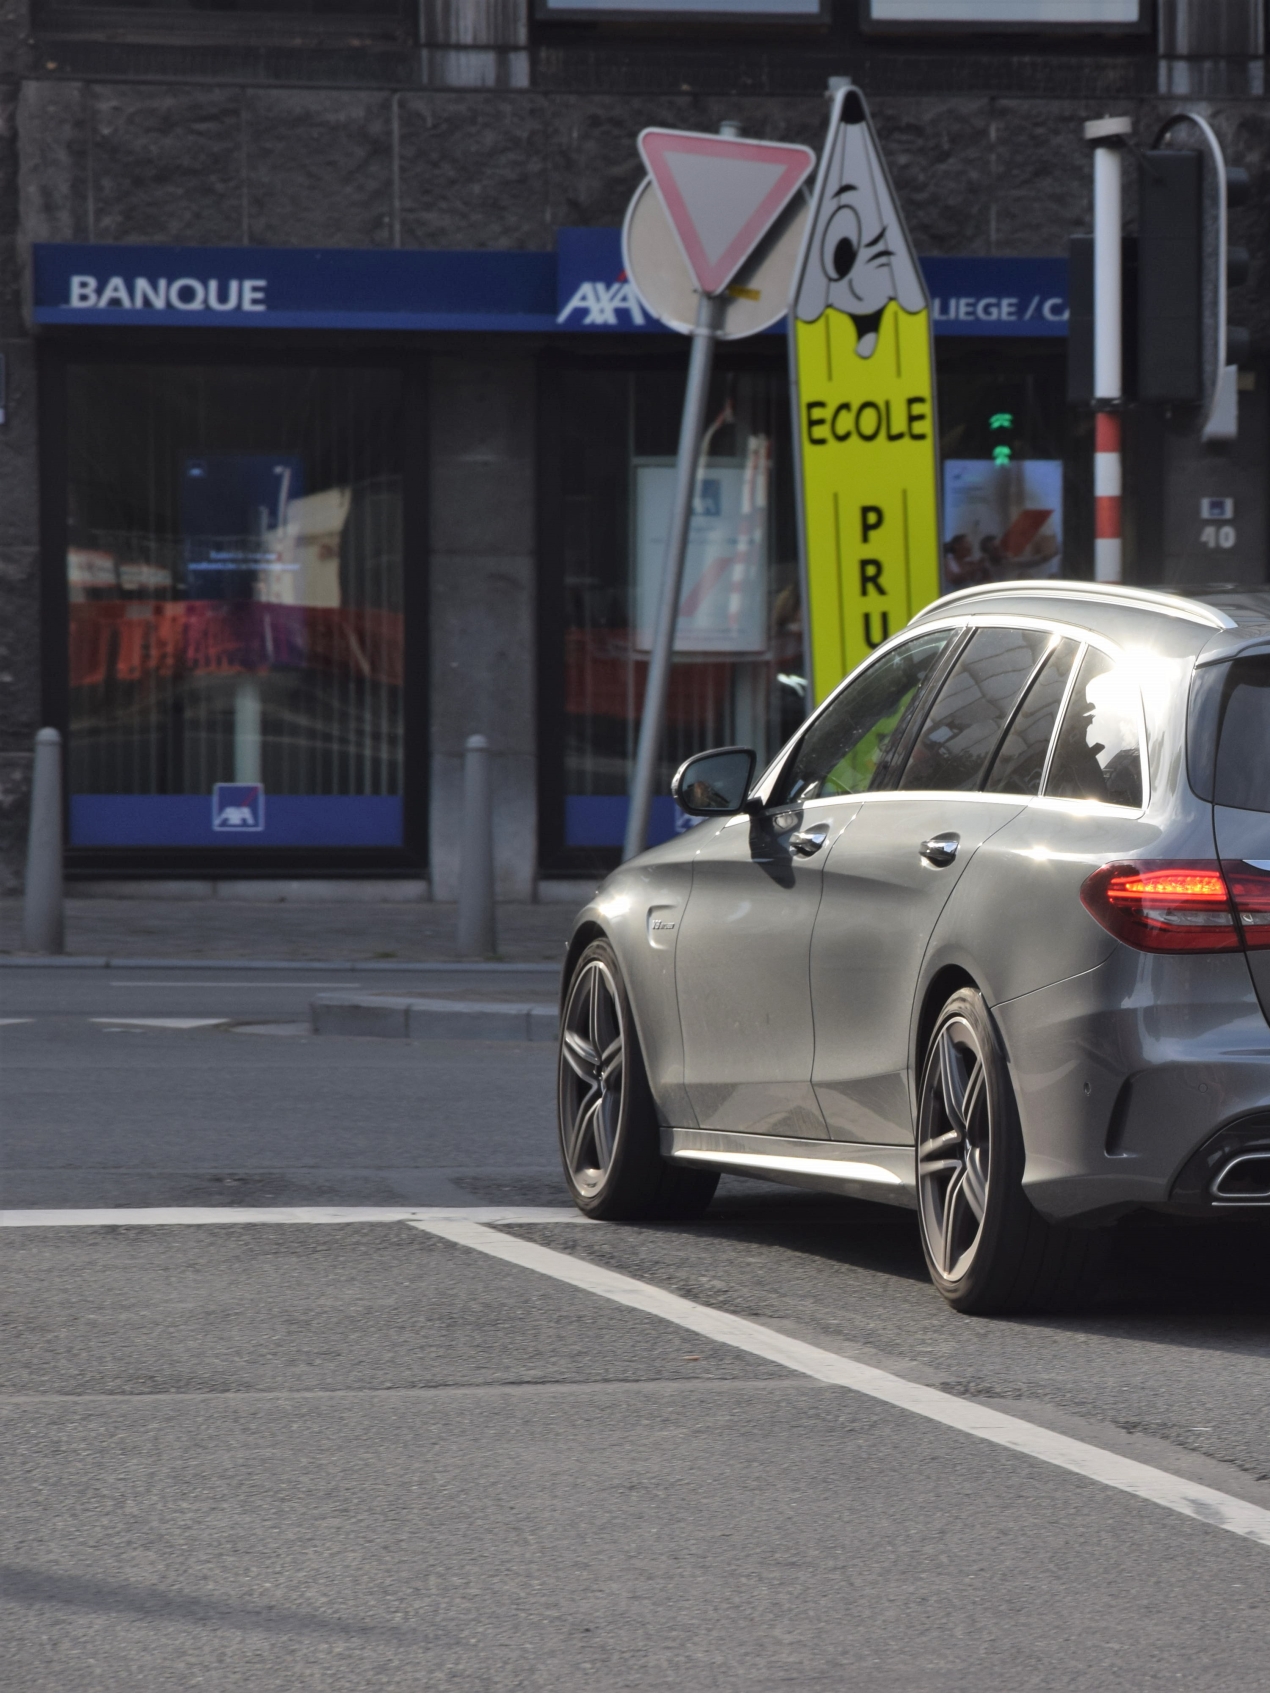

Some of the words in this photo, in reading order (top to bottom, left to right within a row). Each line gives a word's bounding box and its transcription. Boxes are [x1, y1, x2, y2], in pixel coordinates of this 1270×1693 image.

[69, 275, 268, 312] BANQUE
[556, 281, 647, 326] AXA
[932, 297, 1018, 321] LIEGE
[1042, 297, 1070, 321] C
[806, 397, 928, 445] ECOLE
[1200, 525, 1237, 549] 40
[214, 806, 255, 826] AXA
